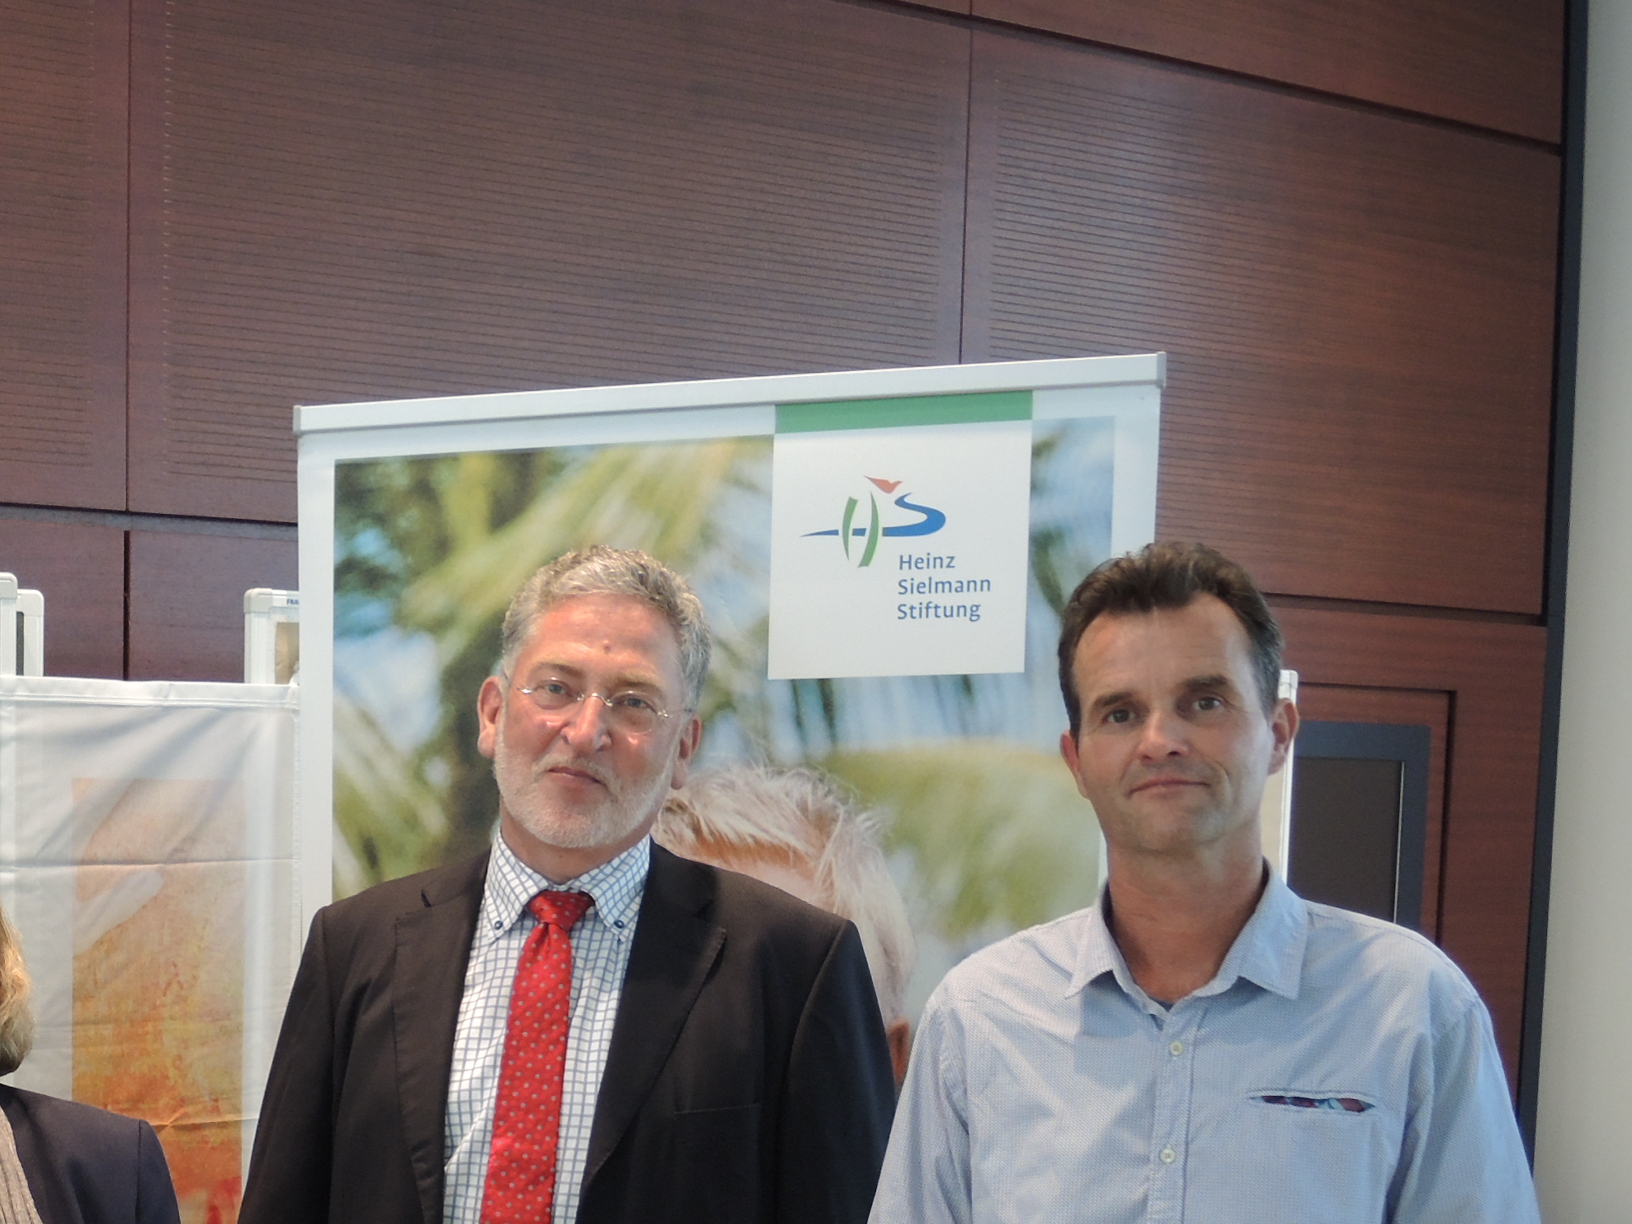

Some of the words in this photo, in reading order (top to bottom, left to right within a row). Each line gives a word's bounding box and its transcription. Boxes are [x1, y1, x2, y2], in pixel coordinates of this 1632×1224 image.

[899, 552, 956, 571] Heinz
[897, 577, 991, 595] Sielmann
[897, 601, 982, 622] Stiftung
